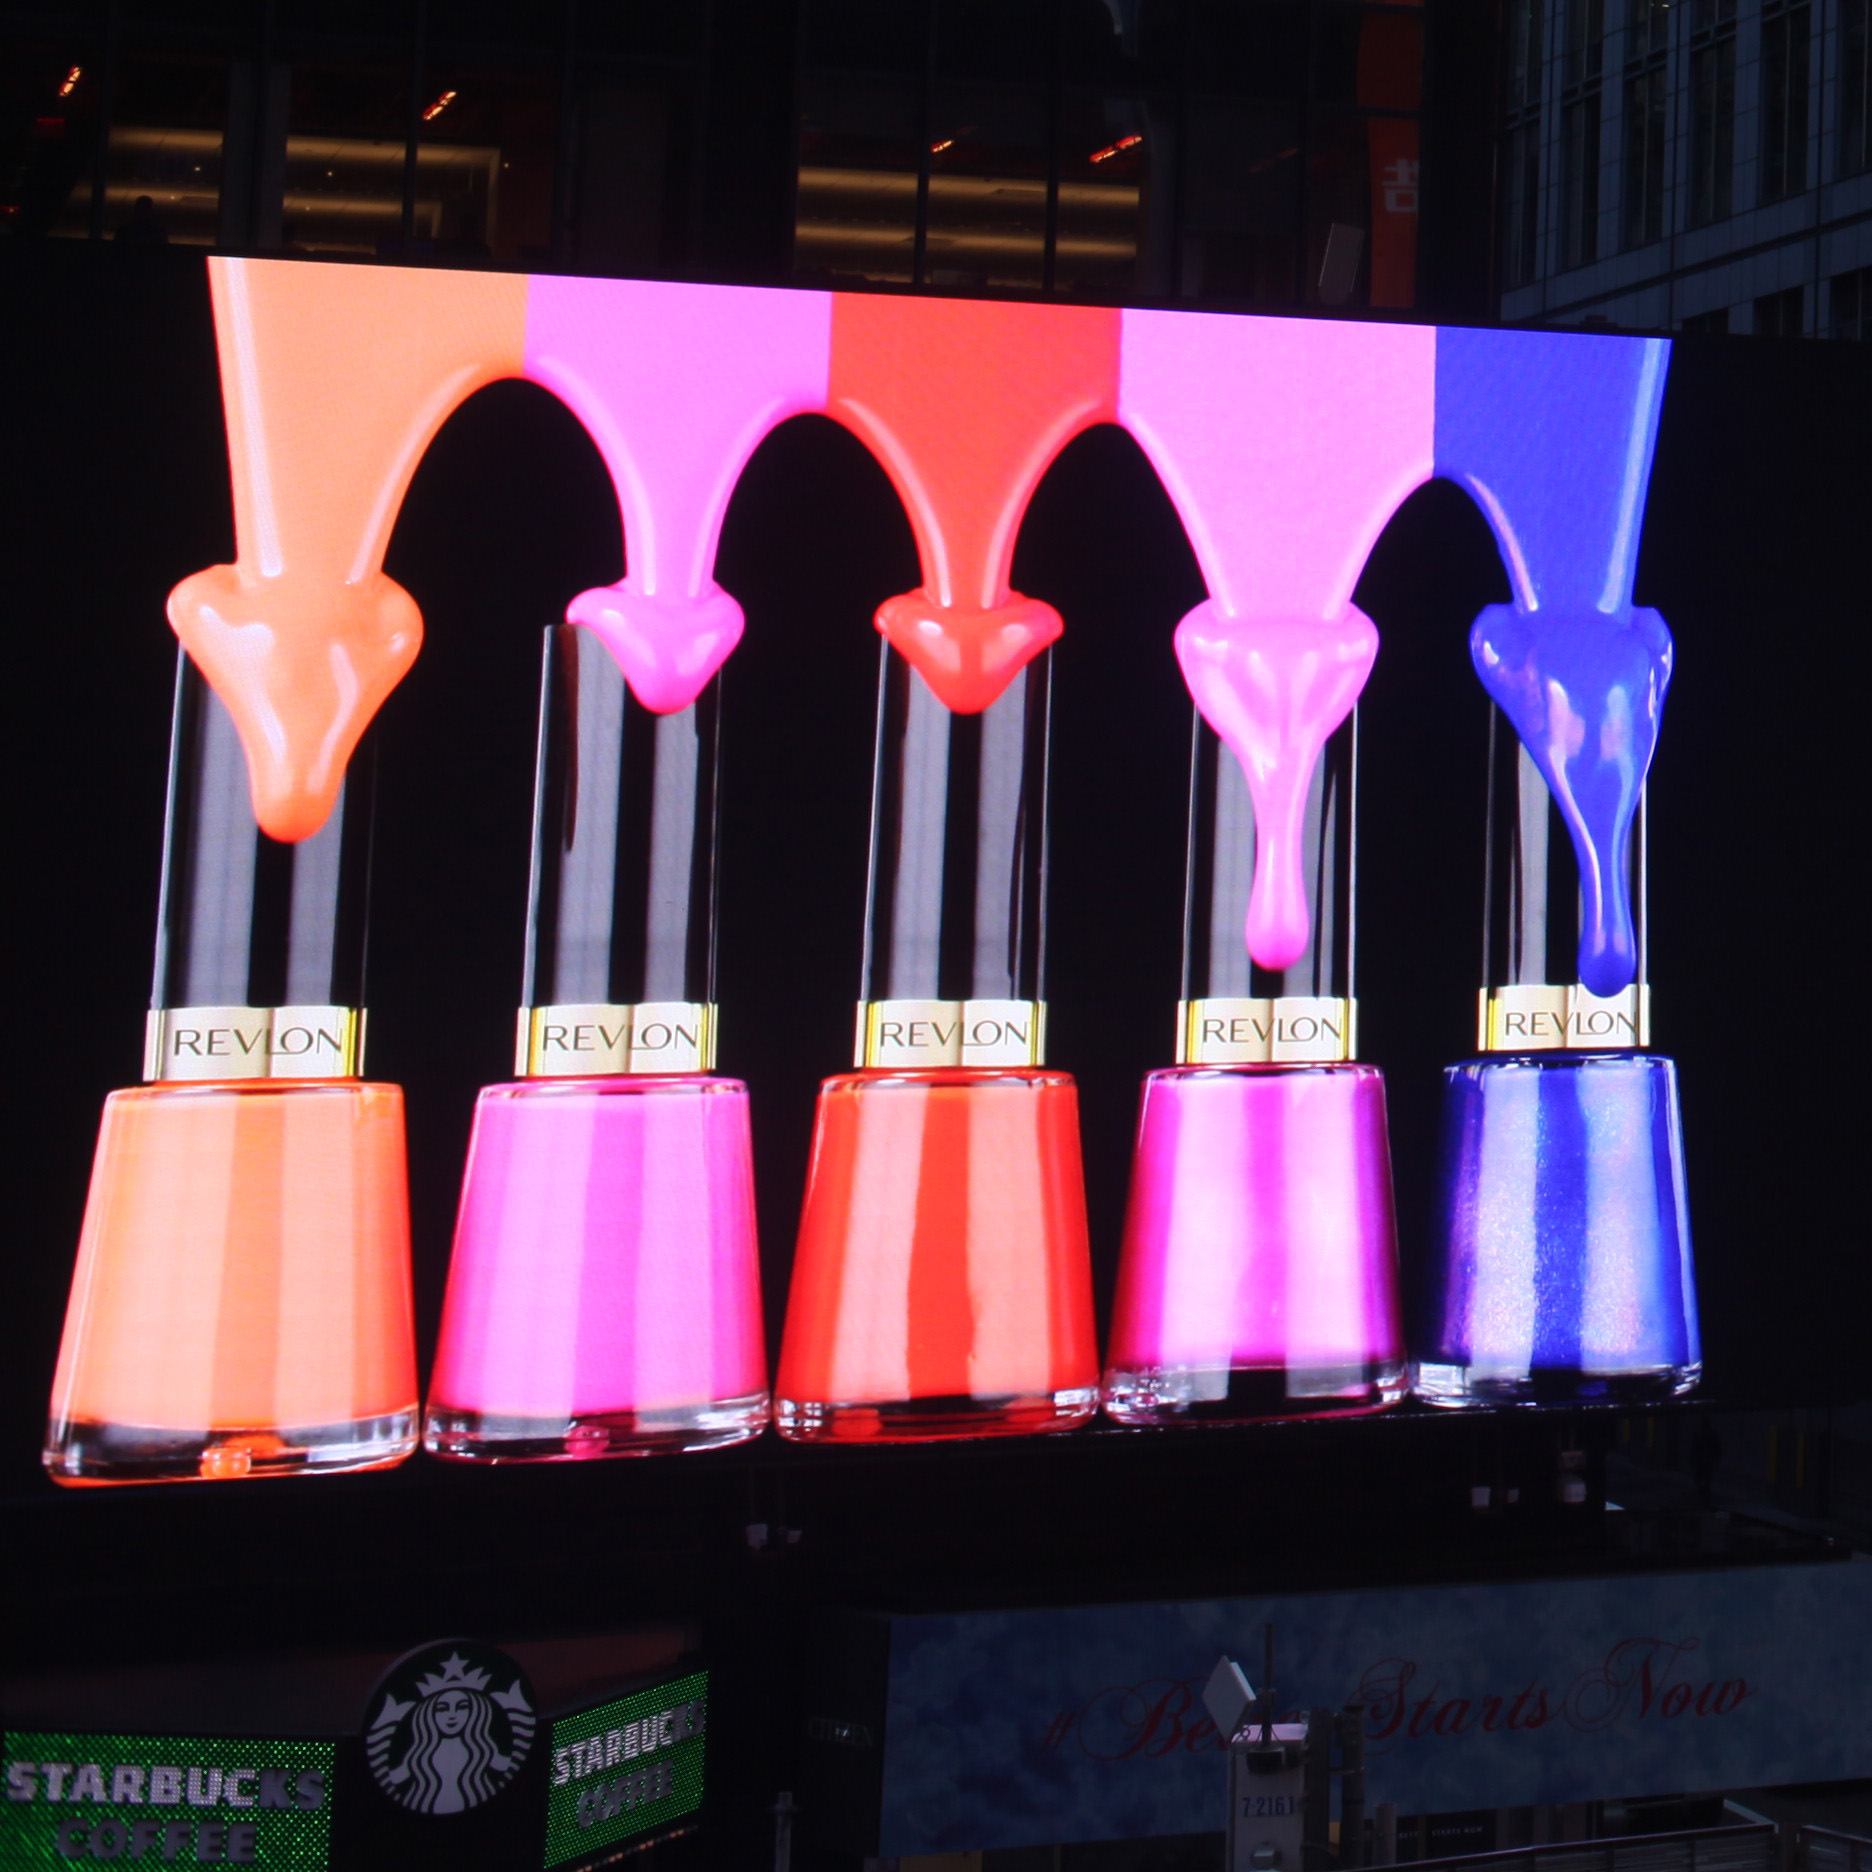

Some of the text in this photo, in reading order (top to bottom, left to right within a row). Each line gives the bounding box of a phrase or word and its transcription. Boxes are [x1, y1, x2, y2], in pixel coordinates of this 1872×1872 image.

[174, 1025, 343, 1057] REVLON
[541, 1022, 699, 1053] REVLON
[879, 1019, 1029, 1049] REVLON
[1202, 1015, 1343, 1044] REVLON
[1504, 1009, 1638, 1037] REVLON
[1563, 1636, 1757, 1734] Now
[552, 1697, 706, 1789] STARBUCKS
[5, 1760, 327, 1811] STARBUCKS
[577, 1757, 678, 1830] COFFEE
[57, 1818, 259, 1866] COFFEE
